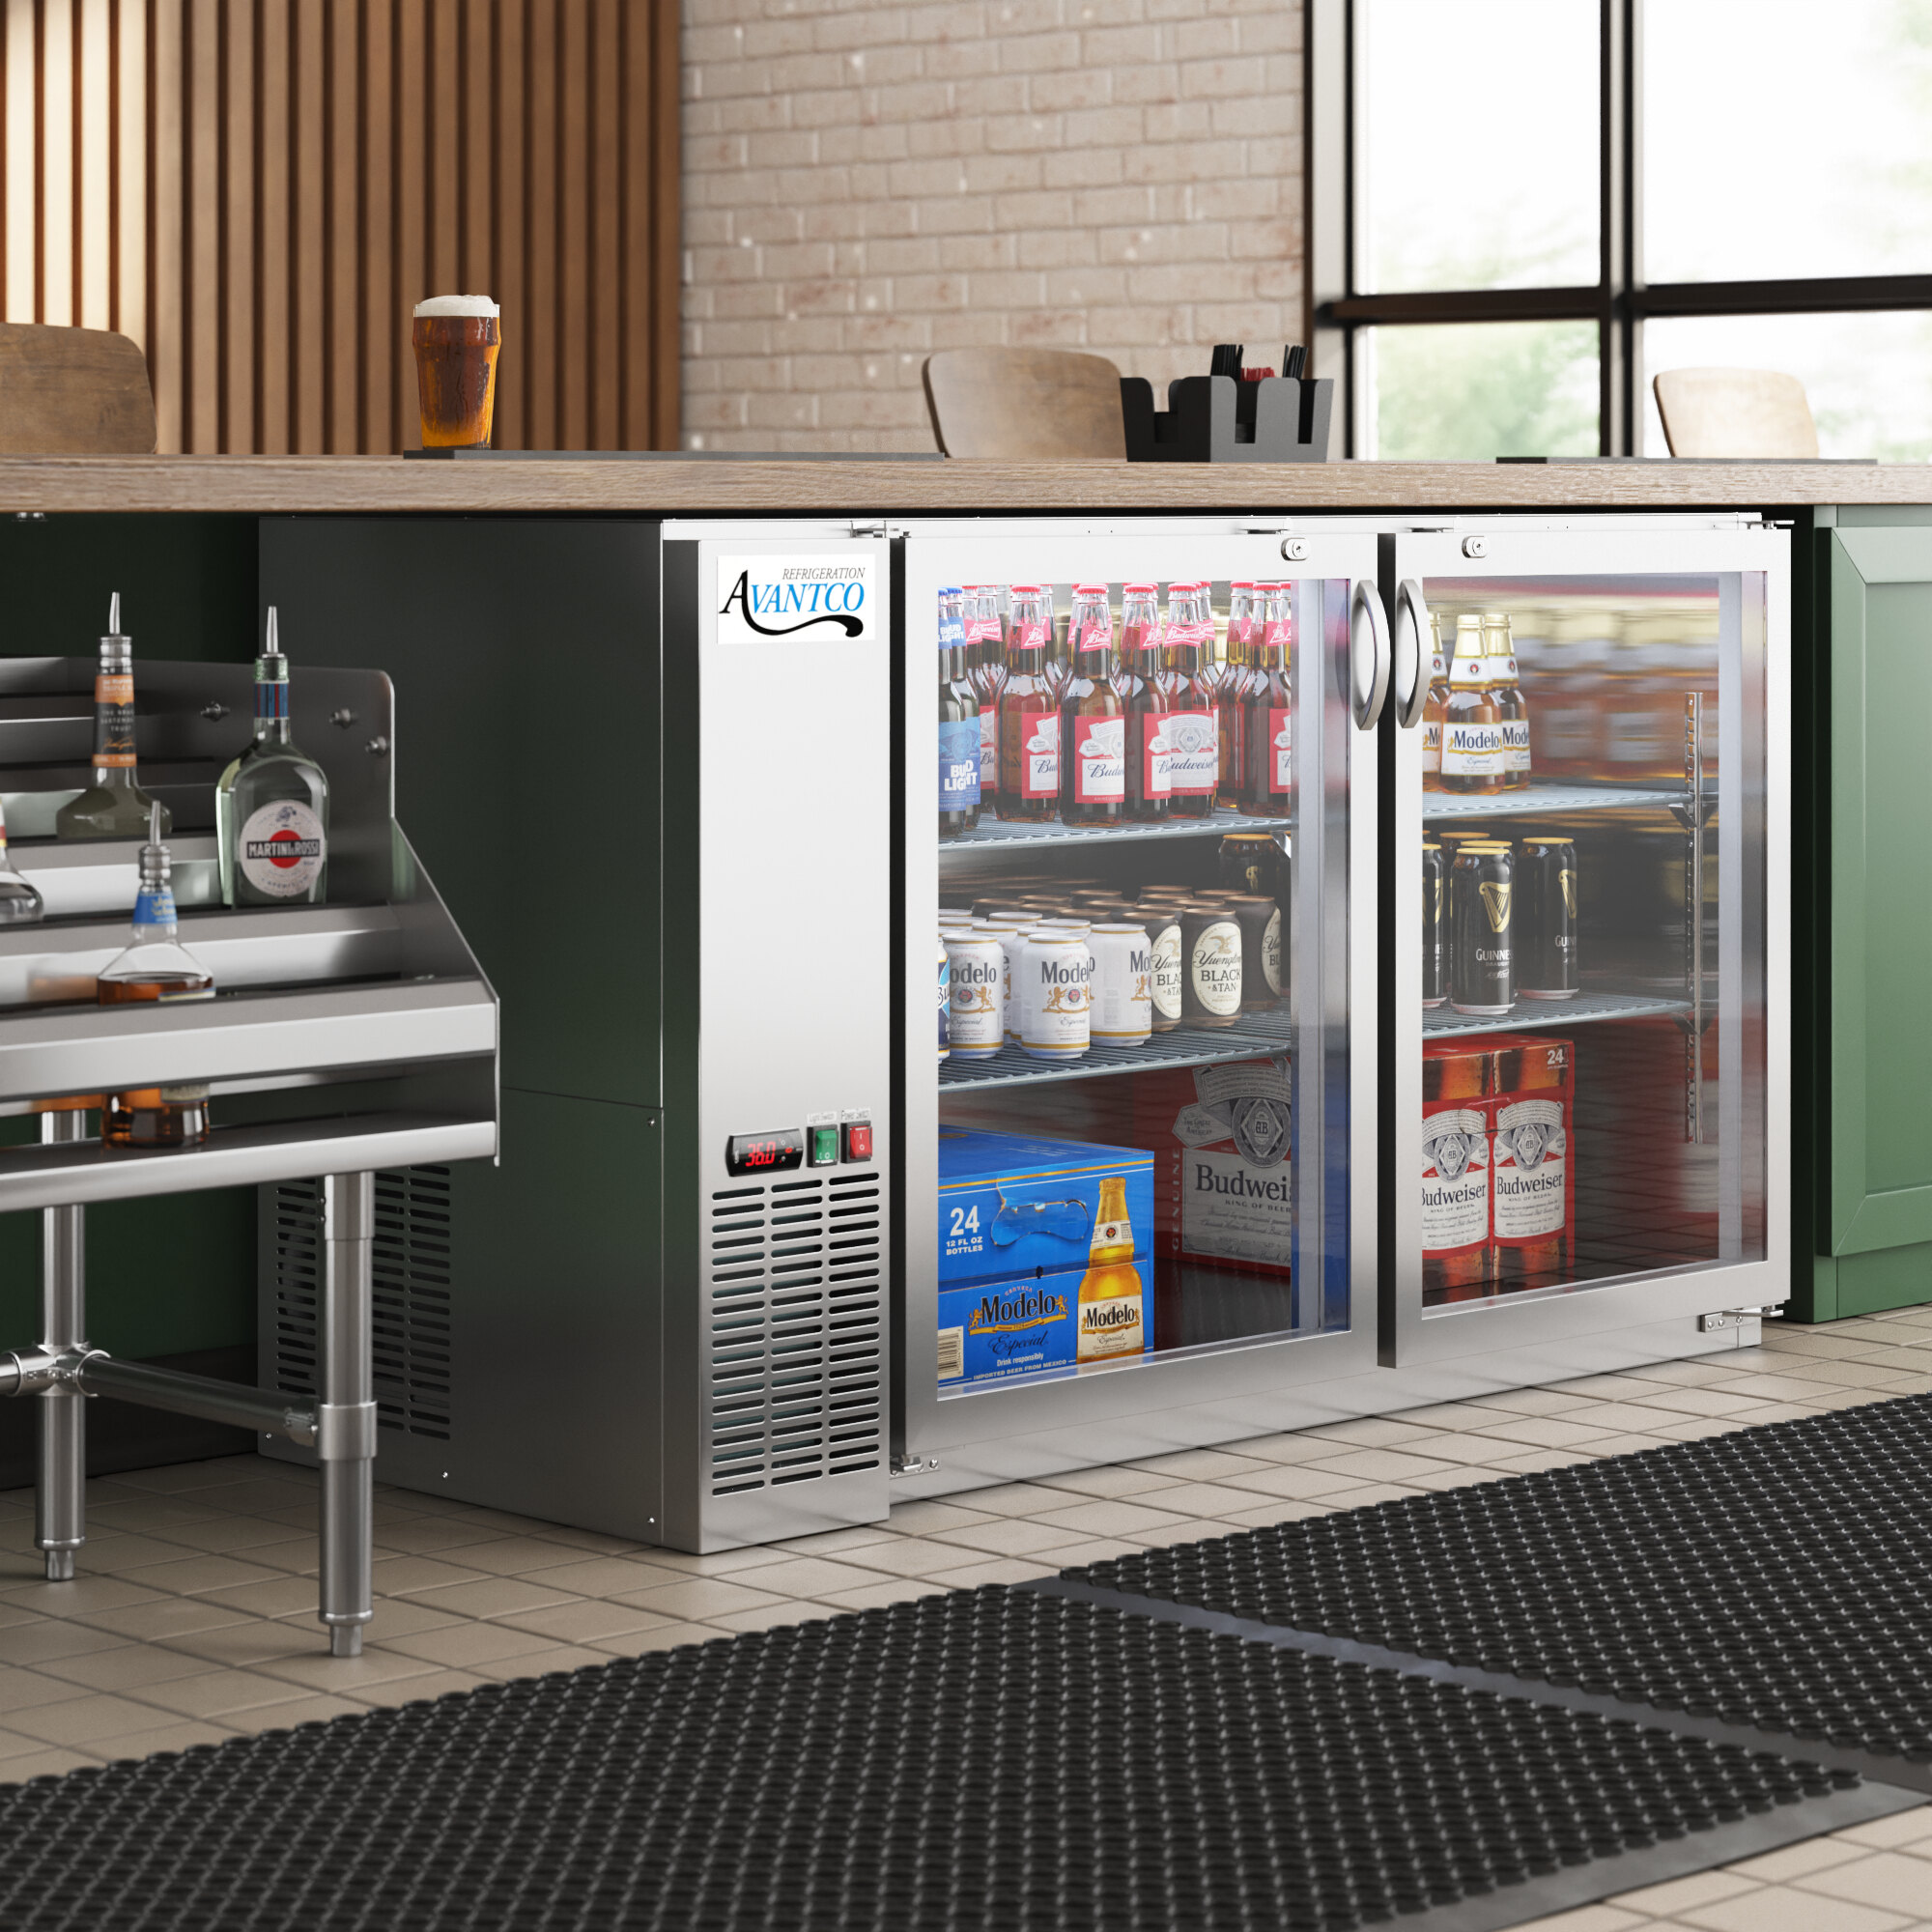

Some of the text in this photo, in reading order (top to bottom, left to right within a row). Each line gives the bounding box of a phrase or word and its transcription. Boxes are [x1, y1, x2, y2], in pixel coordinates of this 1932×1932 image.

[781, 567, 867, 581] REFRIGERATION
[719, 569, 865, 638] AVANTCO
[1454, 729, 1499, 750] Modelo
[950, 759, 974, 779] BUD
[944, 771, 979, 791] LIGHT
[1200, 969, 1241, 981] BLACK
[1547, 1048, 1564, 1065] 24
[1195, 1163, 1291, 1203] Budwei
[1496, 1173, 1563, 1195] Budweiser
[1172, 1148, 1180, 1251] GENUINE
[1225, 1199, 1248, 1208] KING
[950, 1205, 980, 1236] 24
[946, 1244, 983, 1256] BOTTLES
[970, 1236, 983, 1244] OZ
[980, 1290, 1057, 1325] Modelo
[1087, 1304, 1135, 1328] Modelo
[988, 1330, 1049, 1356] Especial
[1012, 1352, 1044, 1364] responsibly
[973, 1370, 1006, 1380] IMPORTED
[1042, 1359, 1067, 1369] MEXICO
